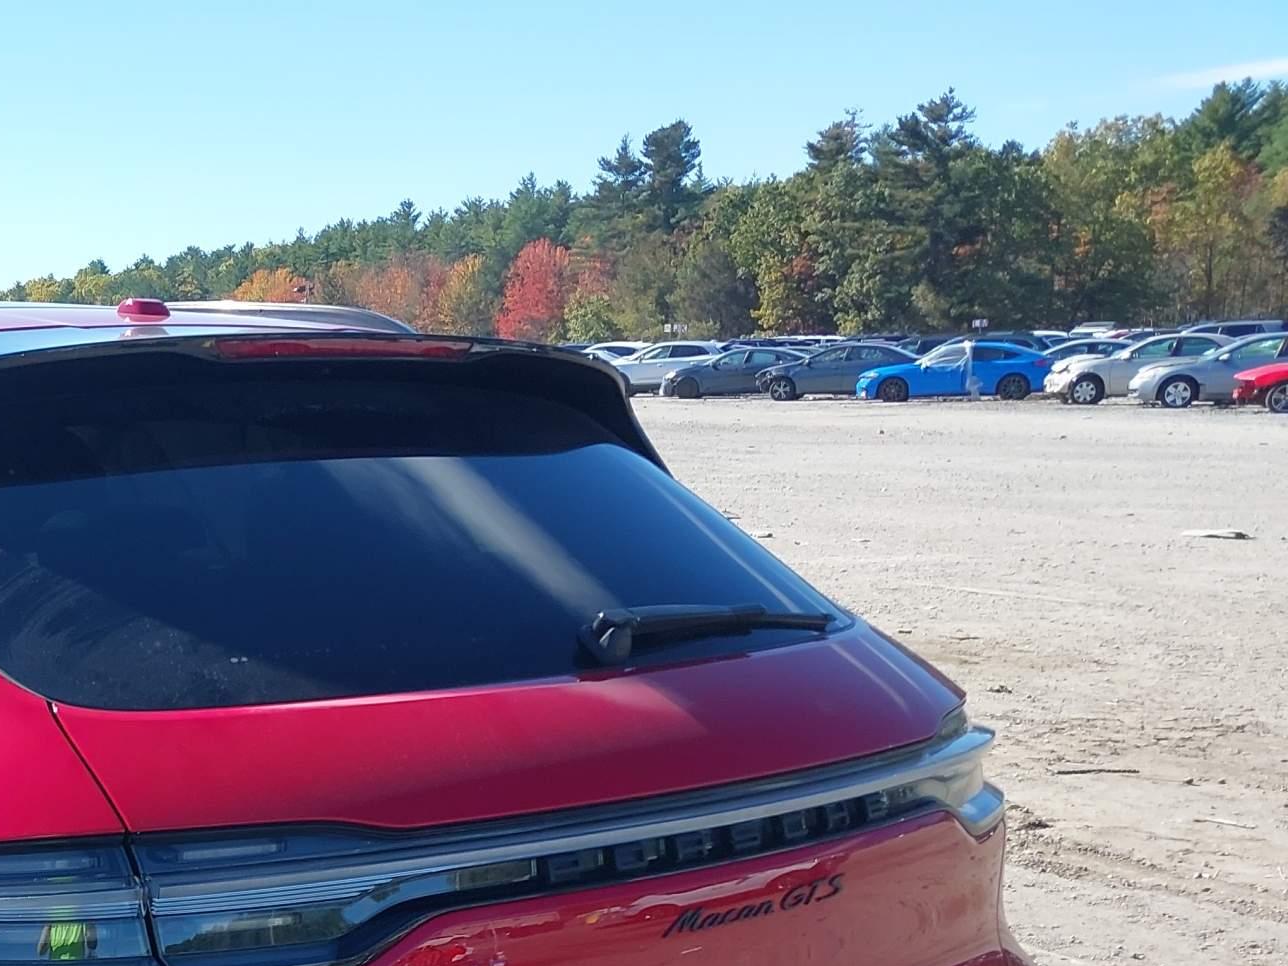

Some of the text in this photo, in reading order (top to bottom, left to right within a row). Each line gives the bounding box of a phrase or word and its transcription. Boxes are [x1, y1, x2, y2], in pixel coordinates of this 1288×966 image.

[548, 792, 887, 881] PORSCHE
[662, 873, 844, 938] Macan GTS
